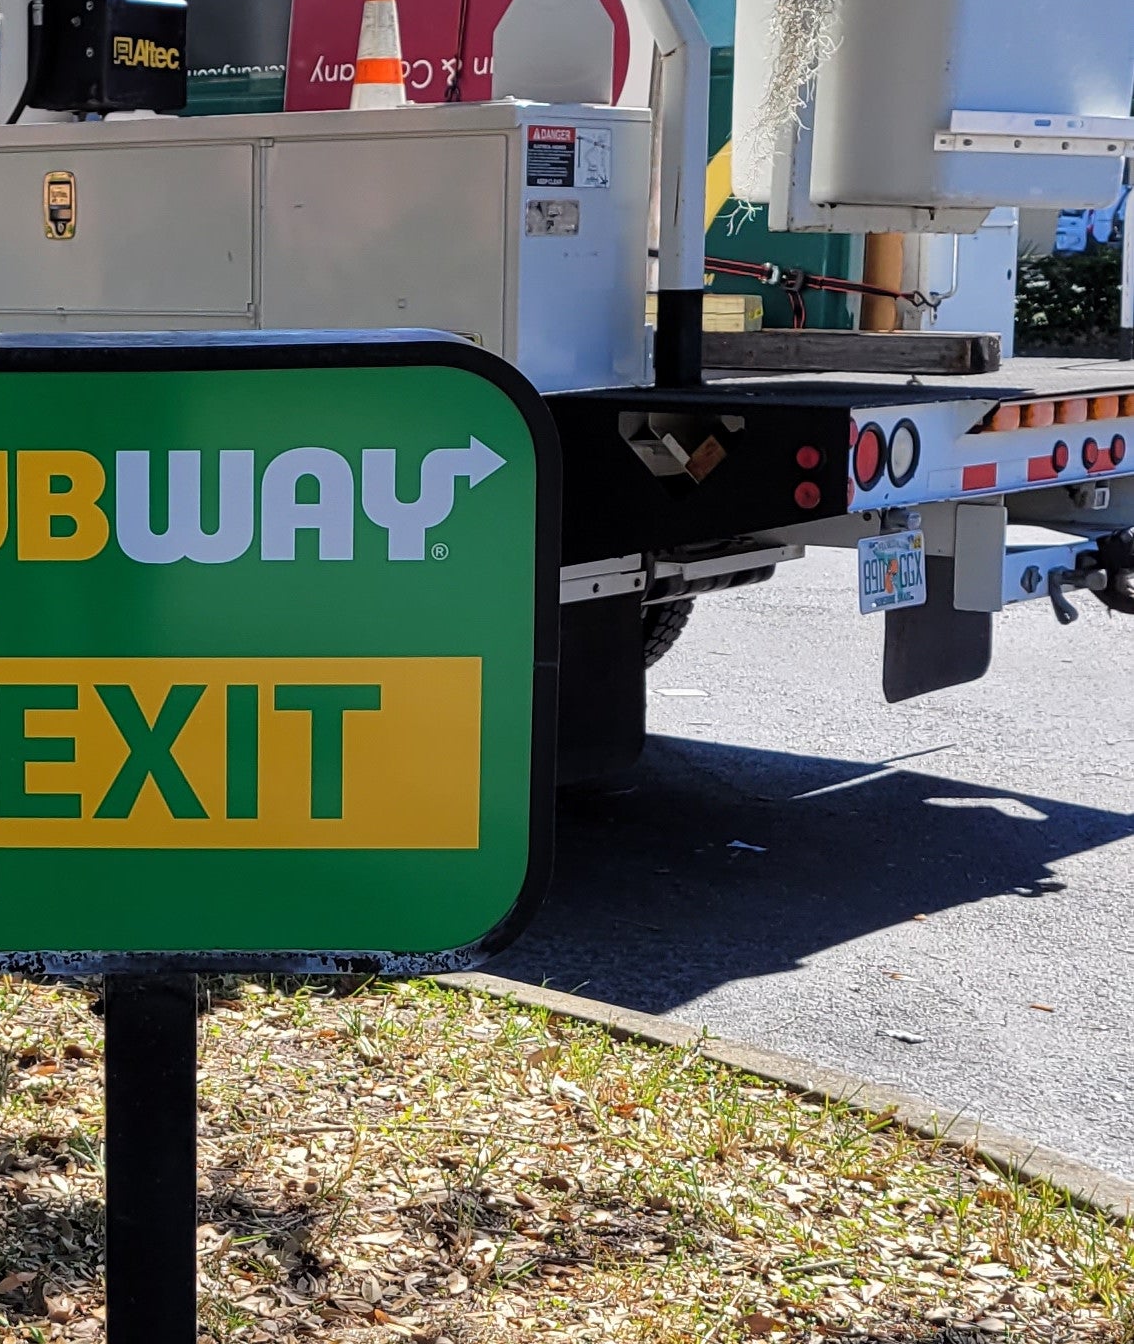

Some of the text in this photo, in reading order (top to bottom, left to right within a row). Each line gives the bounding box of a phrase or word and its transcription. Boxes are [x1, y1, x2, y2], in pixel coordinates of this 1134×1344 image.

[133, 39, 180, 69] Altec
[309, 55, 434, 89] Coany
[540, 129, 571, 141] DANGER
